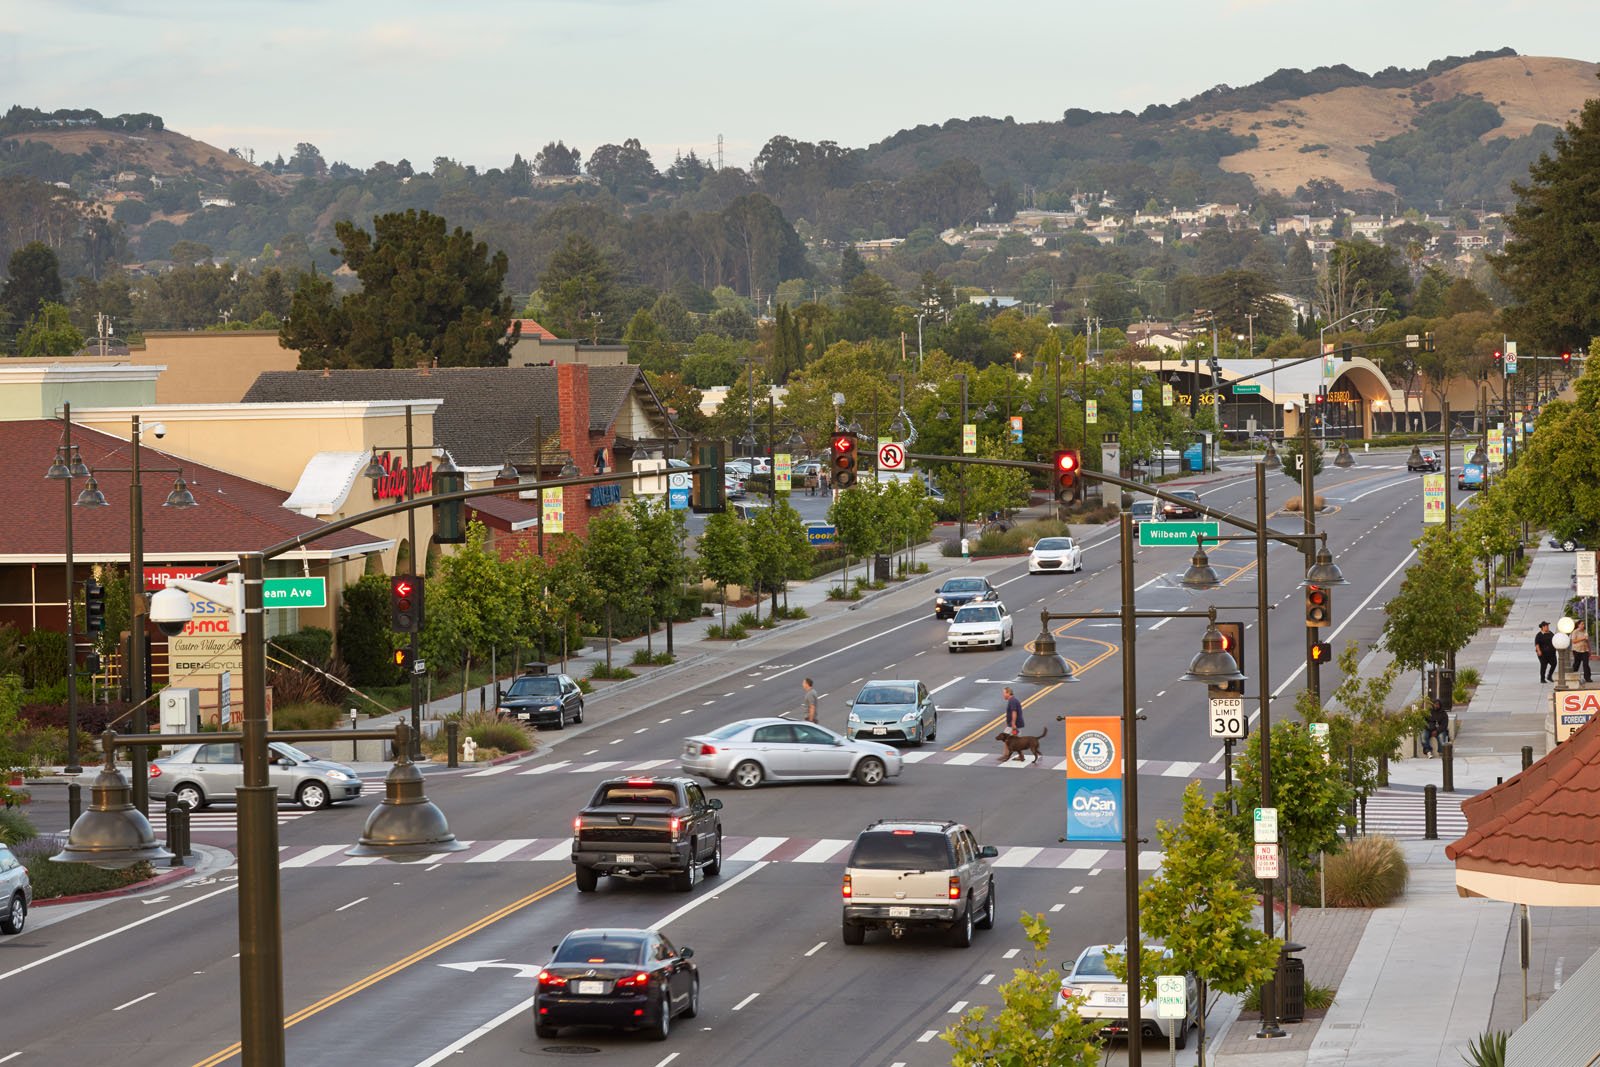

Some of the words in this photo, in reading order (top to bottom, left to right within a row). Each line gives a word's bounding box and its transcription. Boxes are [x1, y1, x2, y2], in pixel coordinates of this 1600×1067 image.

[1334, 390, 1350, 401] FARGO
[1150, 530, 1188, 538] Wilbeam
[290, 588, 312, 598] Ave
[174, 639, 199, 651] Castro
[201, 639, 225, 654] Village
[1212, 699, 1241, 707] SPEED
[1564, 715, 1587, 724] FOREIGN
[1214, 718, 1240, 734] 30
[1083, 742, 1101, 755] 75
[1072, 796, 1116, 811] CVSan
[1255, 810, 1262, 820] 2
[1160, 996, 1184, 1005] PARKING
